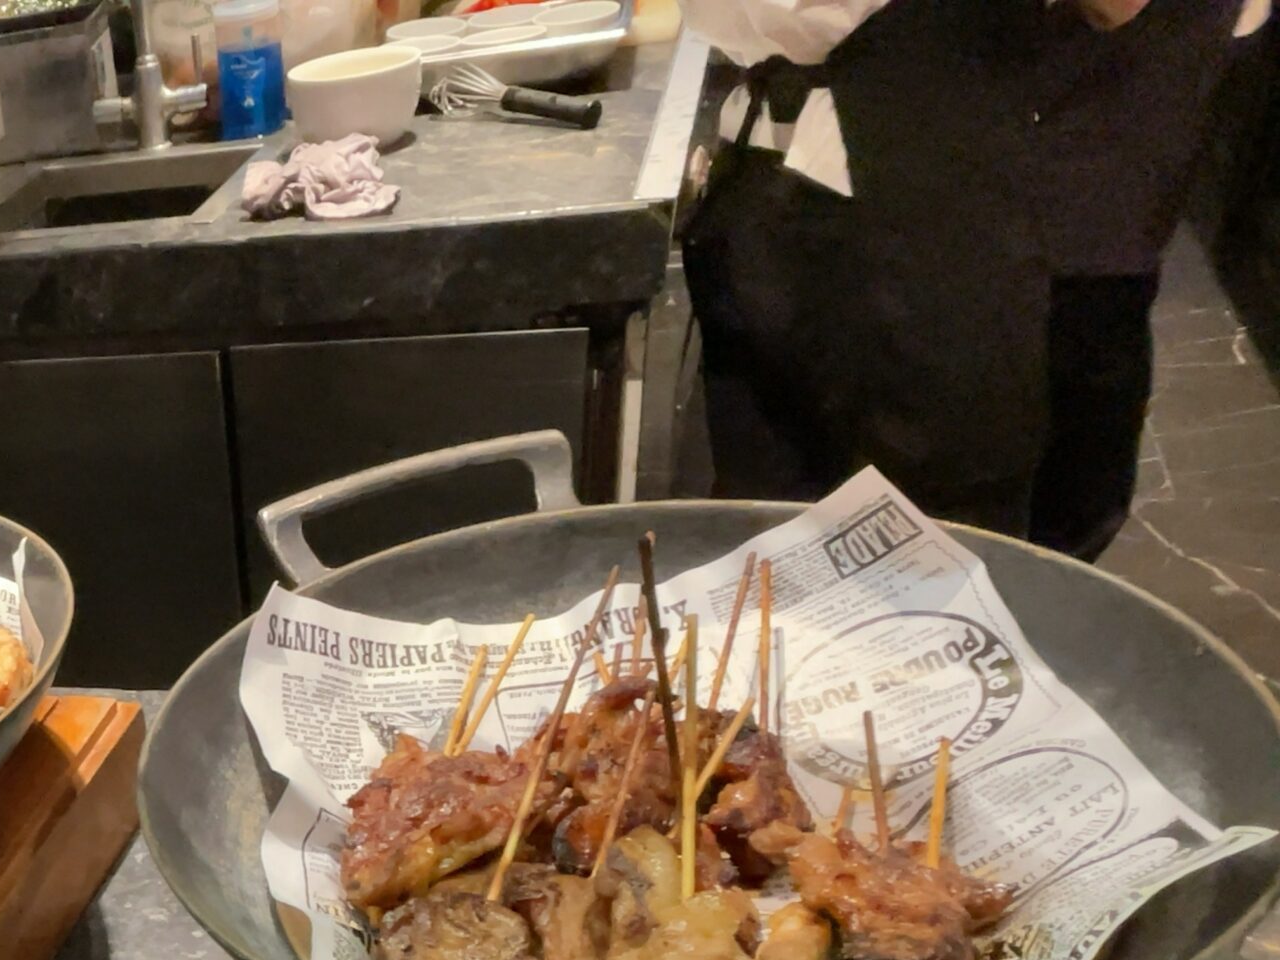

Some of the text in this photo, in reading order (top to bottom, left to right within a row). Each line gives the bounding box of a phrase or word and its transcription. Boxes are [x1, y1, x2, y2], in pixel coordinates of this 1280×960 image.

[828, 504, 920, 577] PELADE
[266, 612, 342, 661] PEINTS
[347, 638, 446, 669] PAPIERS
[971, 644, 1010, 689] Le
[1067, 781, 1120, 818] LAIT
